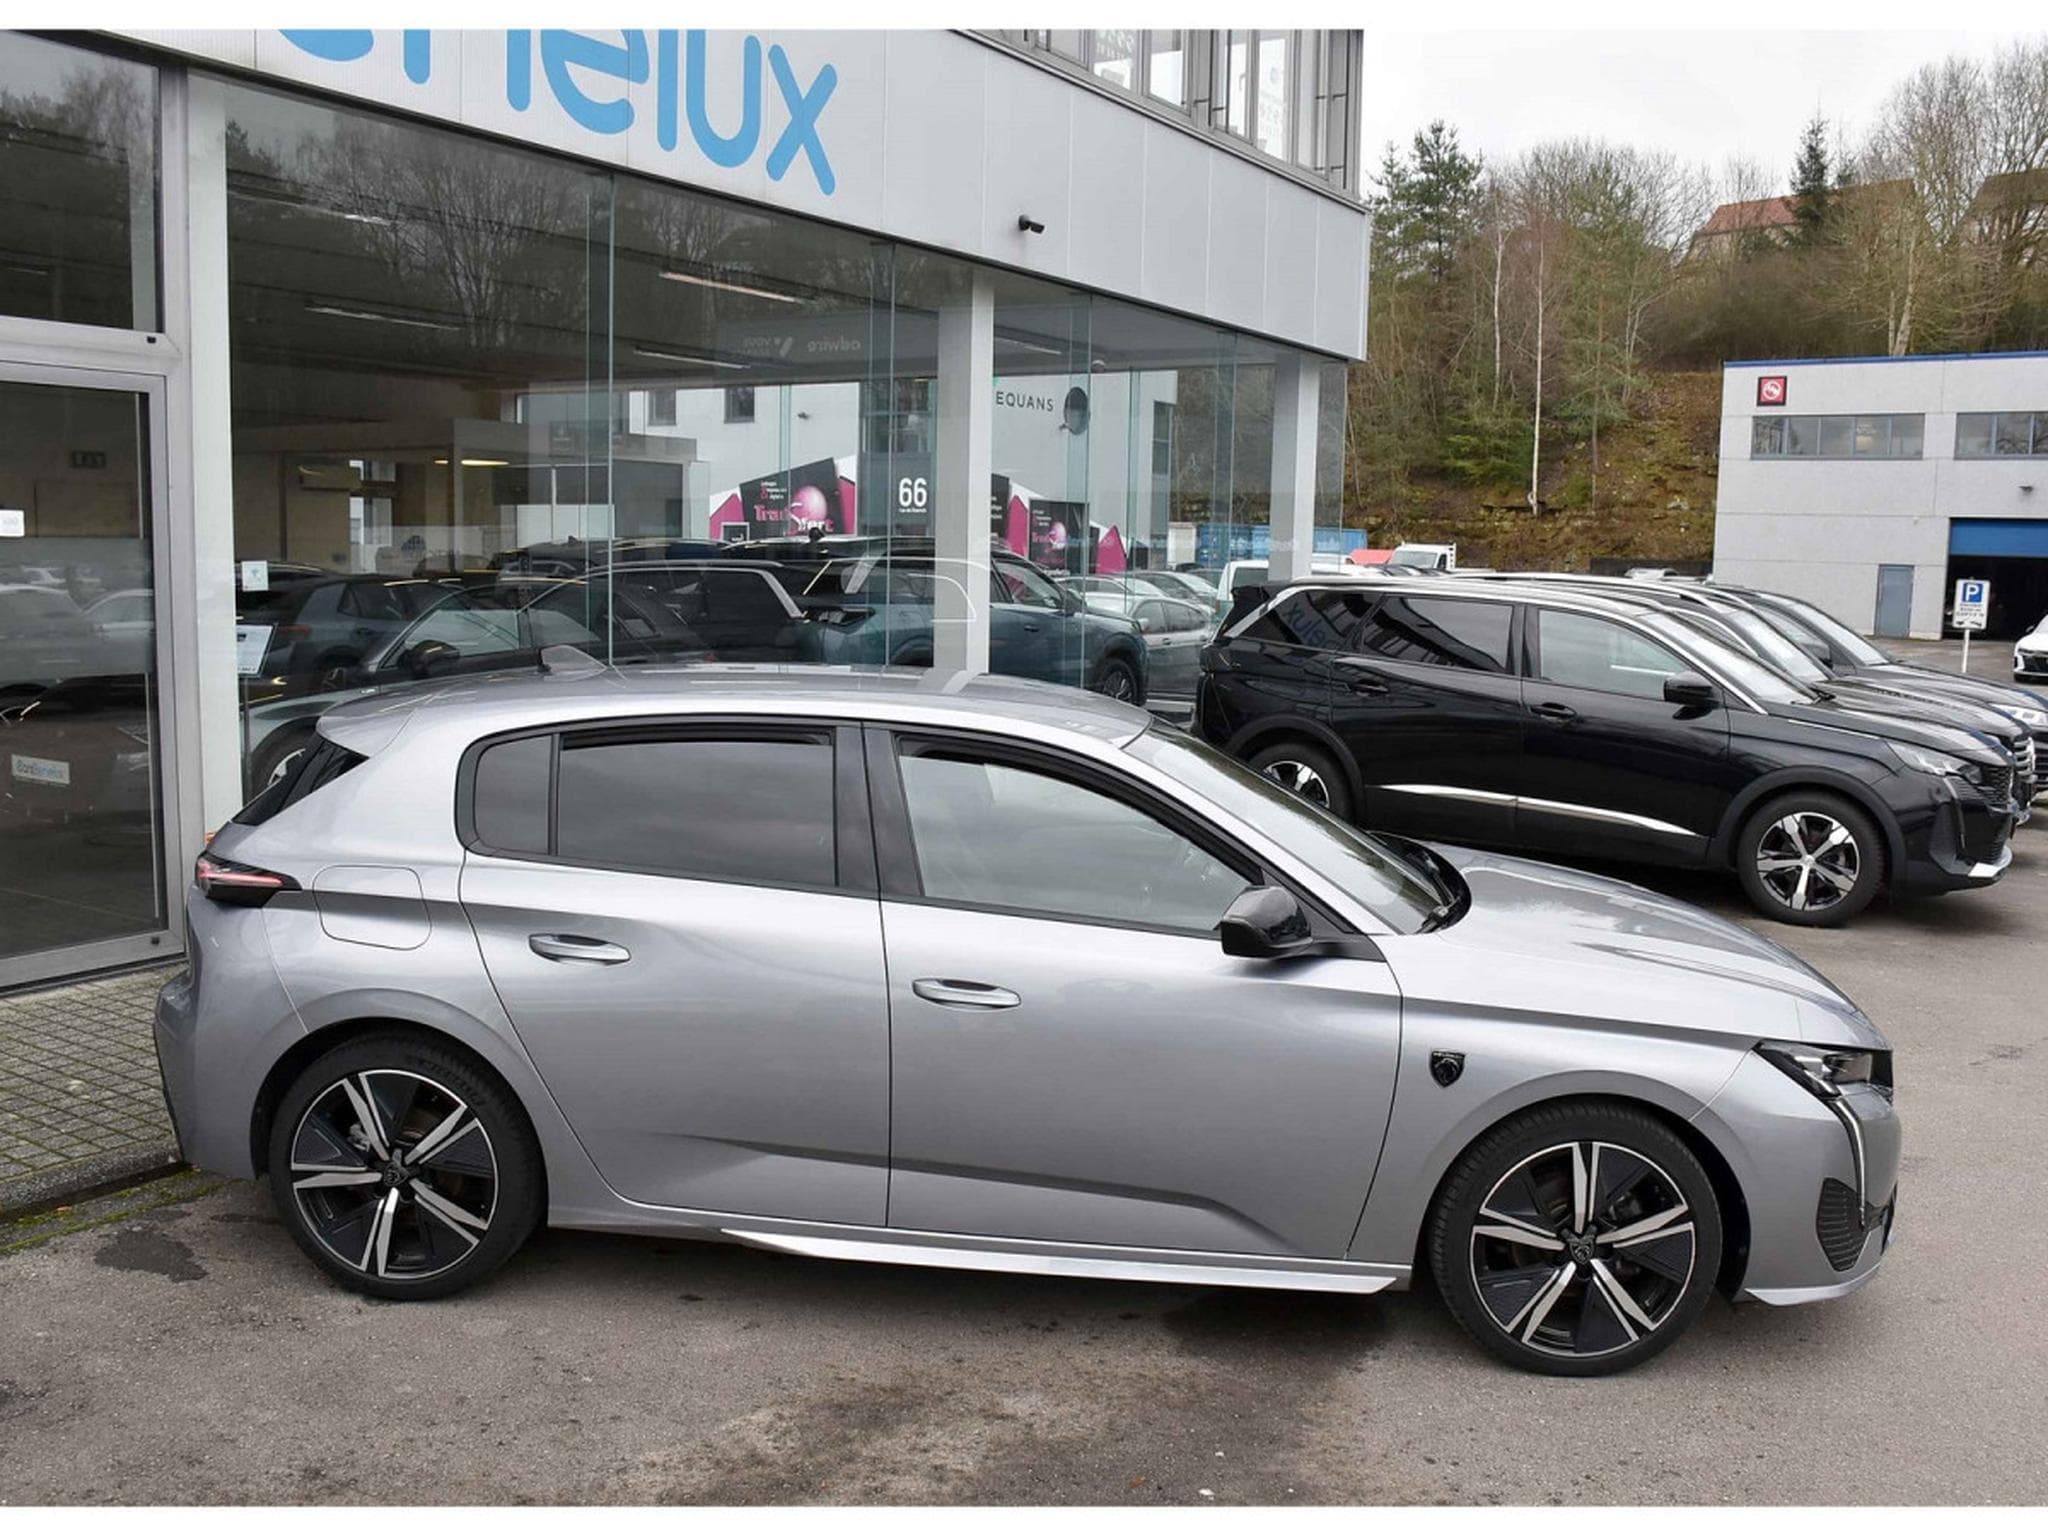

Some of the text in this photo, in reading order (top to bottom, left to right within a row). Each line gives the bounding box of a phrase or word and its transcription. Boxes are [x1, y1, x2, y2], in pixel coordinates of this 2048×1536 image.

[996, 391, 1054, 412] EQUANS
[898, 477, 928, 508] 66
[1965, 584, 1980, 602] P
